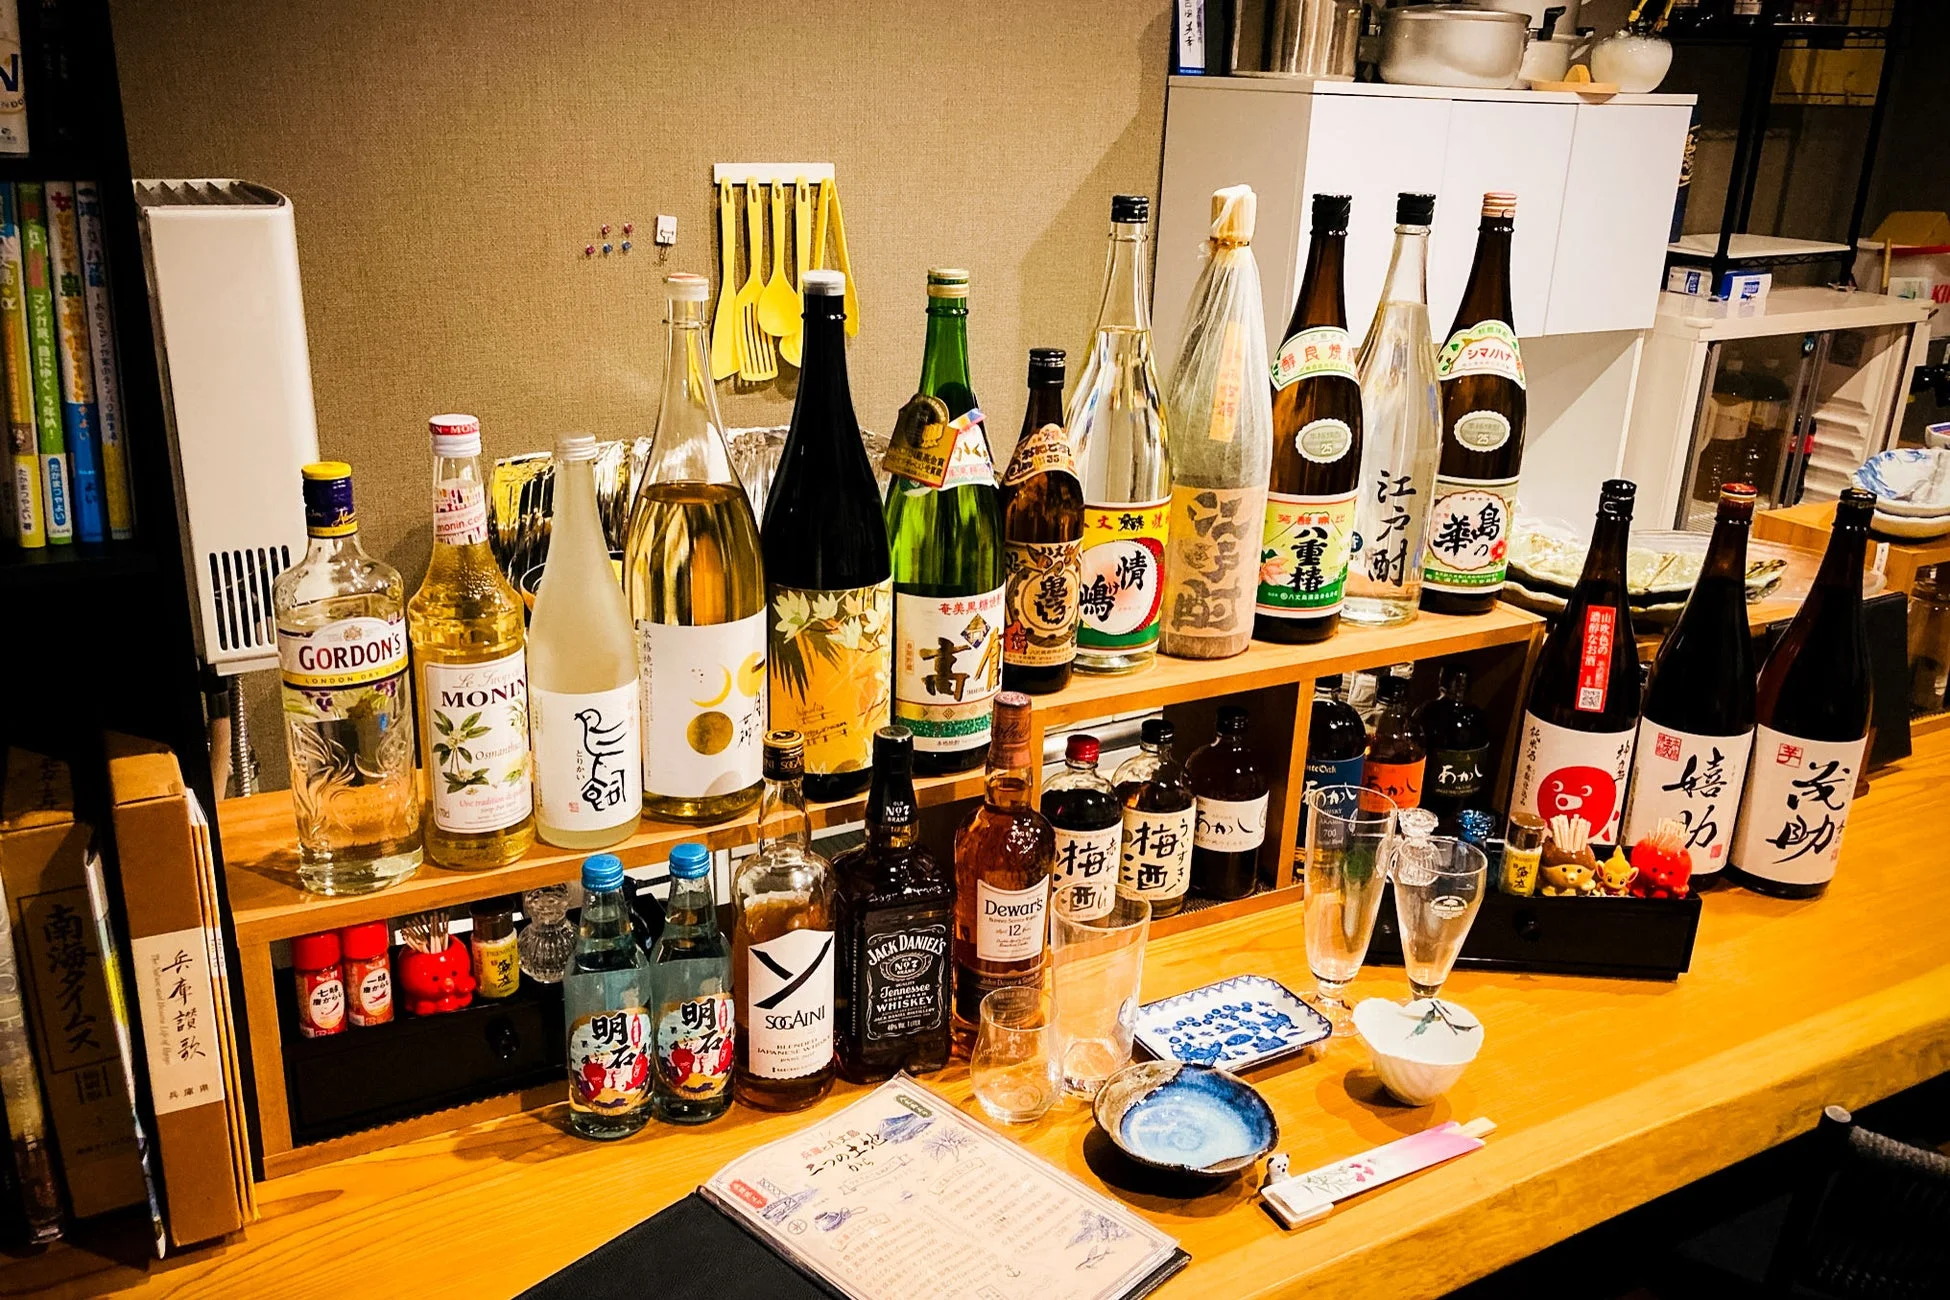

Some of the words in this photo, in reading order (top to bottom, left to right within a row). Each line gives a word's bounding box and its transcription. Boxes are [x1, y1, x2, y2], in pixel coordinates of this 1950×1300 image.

[1468, 347, 1512, 360] シマノハナ
[1321, 443, 1333, 455] 25
[1477, 433, 1489, 445] 25
[51, 464, 65, 520] たかまつやよい
[1287, 527, 1328, 593] 八重椿
[1585, 611, 1601, 667] 濃醇なお酒
[1598, 613, 1612, 656] 山吹色の
[299, 633, 400, 671] GORDON'S
[305, 676, 354, 684] LONDON
[360, 671, 380, 681] DRY
[576, 749, 586, 781] とりかい
[1776, 744, 1802, 765] 芋
[1438, 763, 1484, 785] あかし
[1301, 780, 1357, 807] あかし
[1366, 775, 1417, 798] あかし
[1195, 810, 1254, 835] あかし
[1122, 821, 1179, 890] 梅酒
[984, 898, 1043, 917] Dewar's
[1008, 924, 1021, 936] 12
[867, 939, 899, 966] JACK
[899, 934, 946, 955] DANIEL'S
[367, 973, 386, 984] 一味
[317, 985, 339, 998] 七味
[880, 983, 931, 999] Tennessee
[876, 995, 934, 1013] WHISKEY
[681, 998, 723, 1055] 明石
[765, 1004, 825, 1030] SOGAINI
[592, 1013, 636, 1070] 明石
[848, 1157, 874, 1173] から
